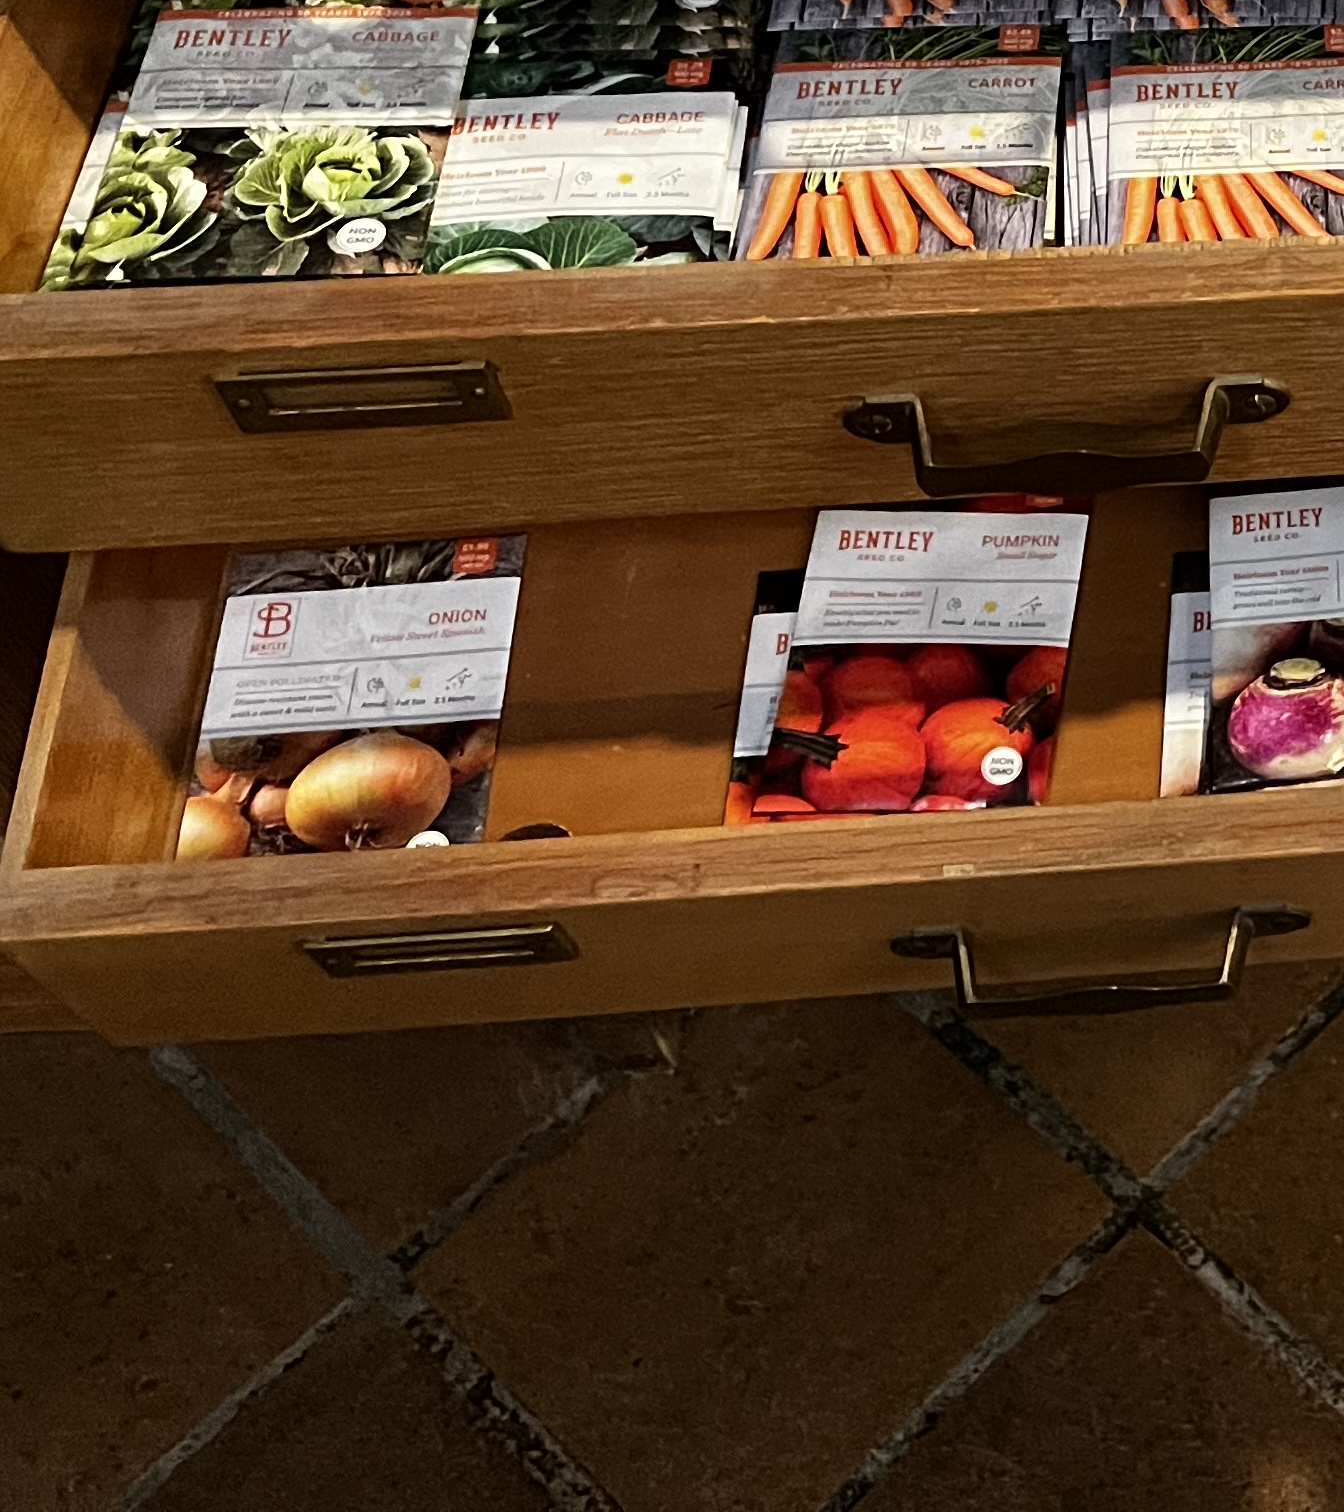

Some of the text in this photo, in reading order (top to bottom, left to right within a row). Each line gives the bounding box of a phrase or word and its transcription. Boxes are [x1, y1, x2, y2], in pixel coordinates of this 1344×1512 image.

[174, 28, 292, 50] BENTLEY
[352, 30, 440, 43] CABBAGE
[797, 78, 901, 100] BENTLEY
[968, 77, 1036, 89] CARROT
[1136, 81, 1238, 103] BENTLEY
[453, 113, 560, 136] BENTLEY
[617, 111, 704, 124] CABBAGE
[1232, 508, 1324, 533] BENTLEY
[838, 530, 934, 553] BENTLEY
[982, 533, 1060, 549] PUMPKIN
[428, 609, 487, 626] ONION
